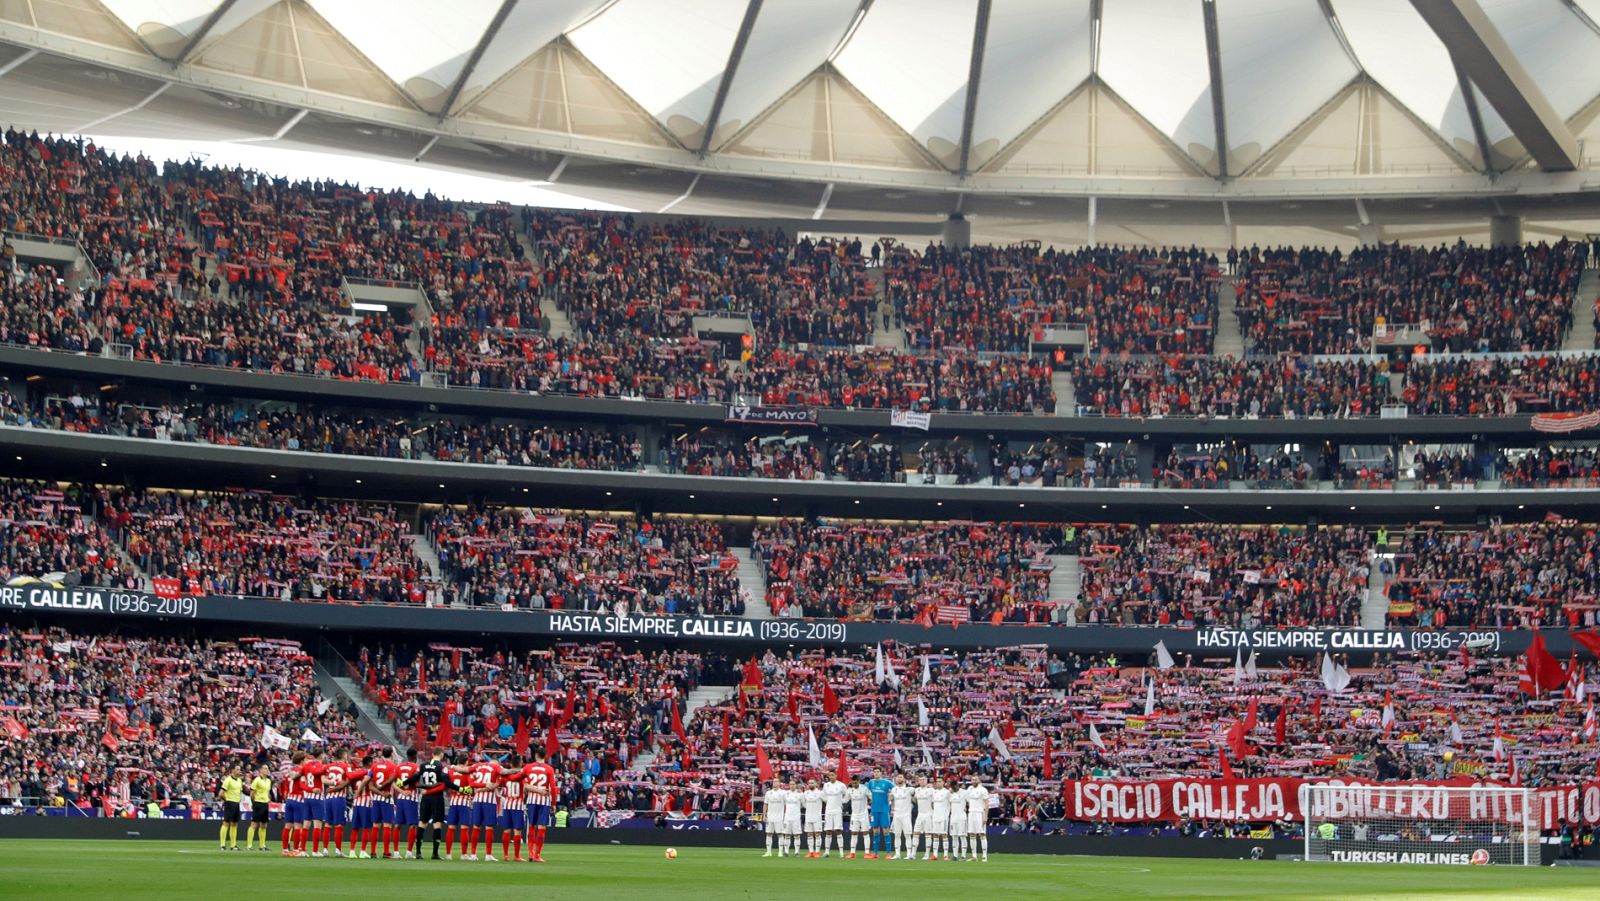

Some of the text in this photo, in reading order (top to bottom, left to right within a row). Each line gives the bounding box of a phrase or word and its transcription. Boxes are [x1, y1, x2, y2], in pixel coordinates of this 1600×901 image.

[729, 406, 751, 419] 17
[765, 410, 807, 420] MAYO
[30, 589, 103, 610] CALLEJA
[109, 592, 198, 618] (1936-2019)
[549, 614, 847, 643] HASTA SIEMPRE, CALLEJA (1936-2019)
[1196, 630, 1249, 647] HASTA
[1252, 631, 1328, 650] SIEMPRE,
[1331, 631, 1405, 648] CALLEJA
[307, 772, 315, 788] 8
[376, 771, 385, 788] 2
[422, 771, 438, 785] 13
[528, 773, 548, 788] 22
[505, 780, 520, 798] 10
[1074, 781, 1162, 819] ISACIO
[1172, 781, 1294, 822] CALLEJA,
[1331, 850, 1470, 866] TURKISH AIRLINES
